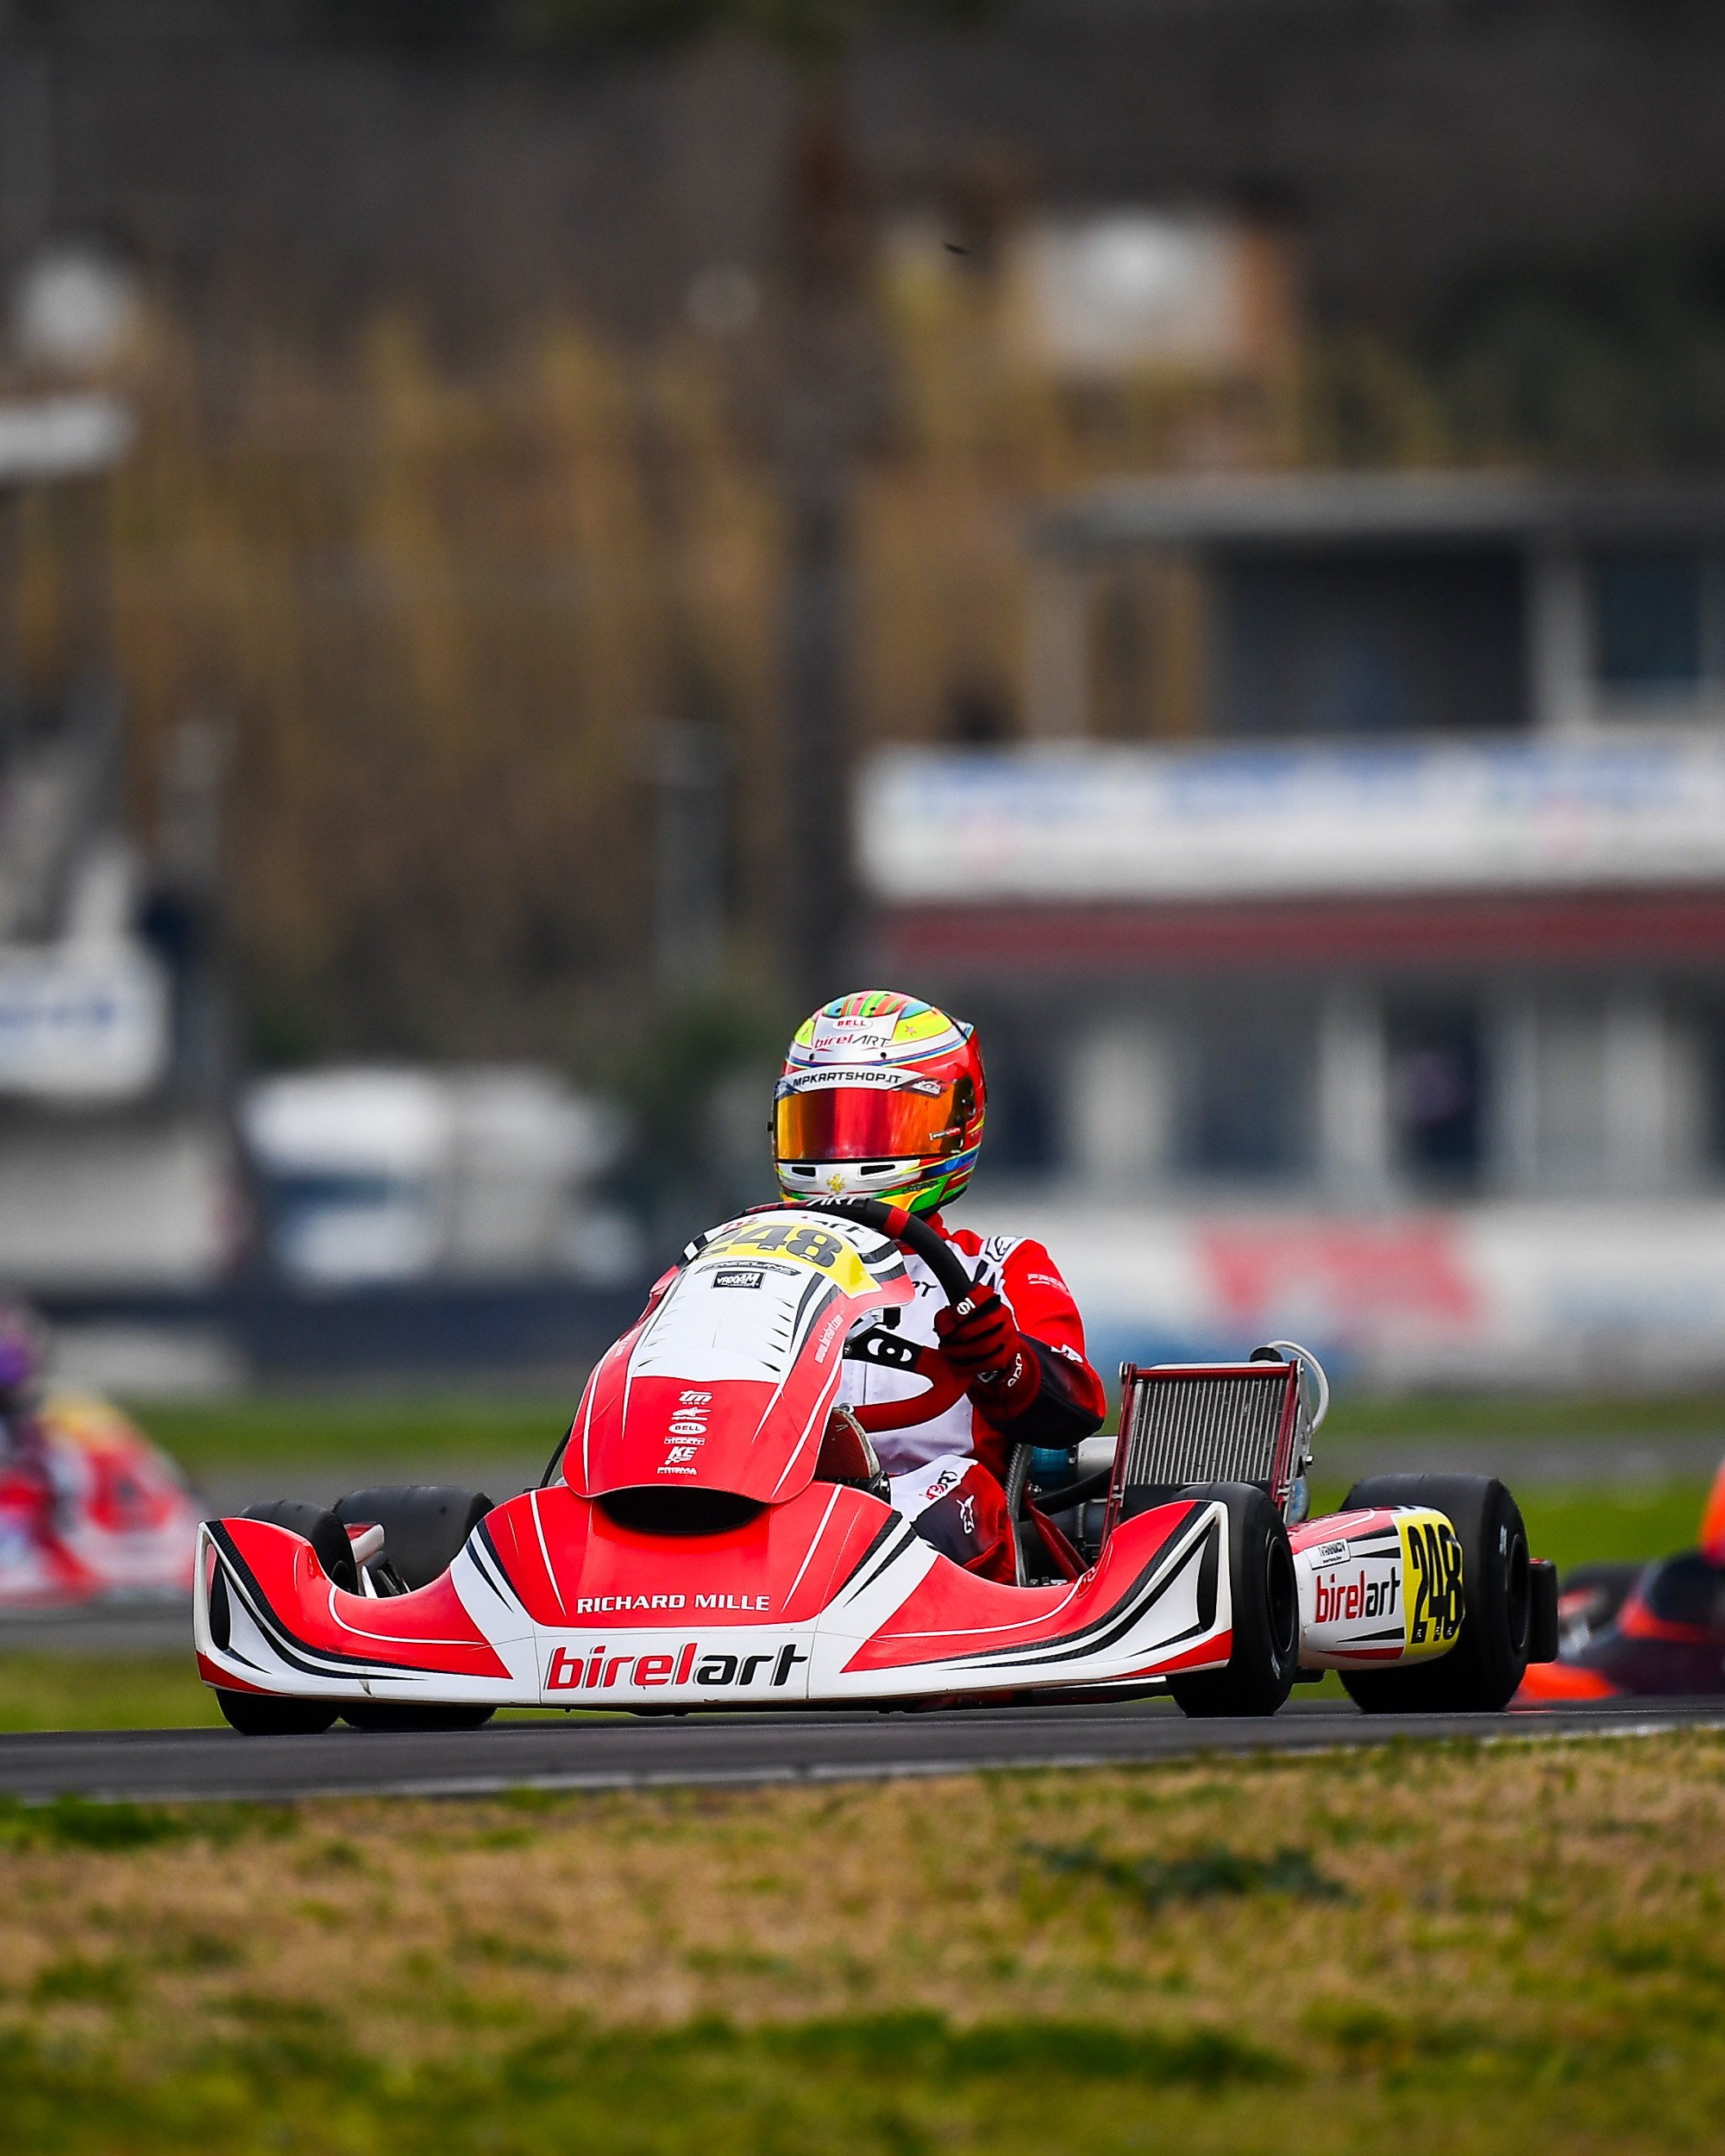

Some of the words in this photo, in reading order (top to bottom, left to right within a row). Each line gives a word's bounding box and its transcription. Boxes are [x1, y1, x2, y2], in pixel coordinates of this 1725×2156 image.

[794, 1071, 901, 1087] MPKARTSHOP.IT
[577, 1595, 686, 1614] RICHARD
[694, 1594, 770, 1612] MILLE
[1314, 1566, 1402, 1624] birelart
[1407, 1523, 1465, 1645] 248
[543, 1643, 809, 1690] birelart
